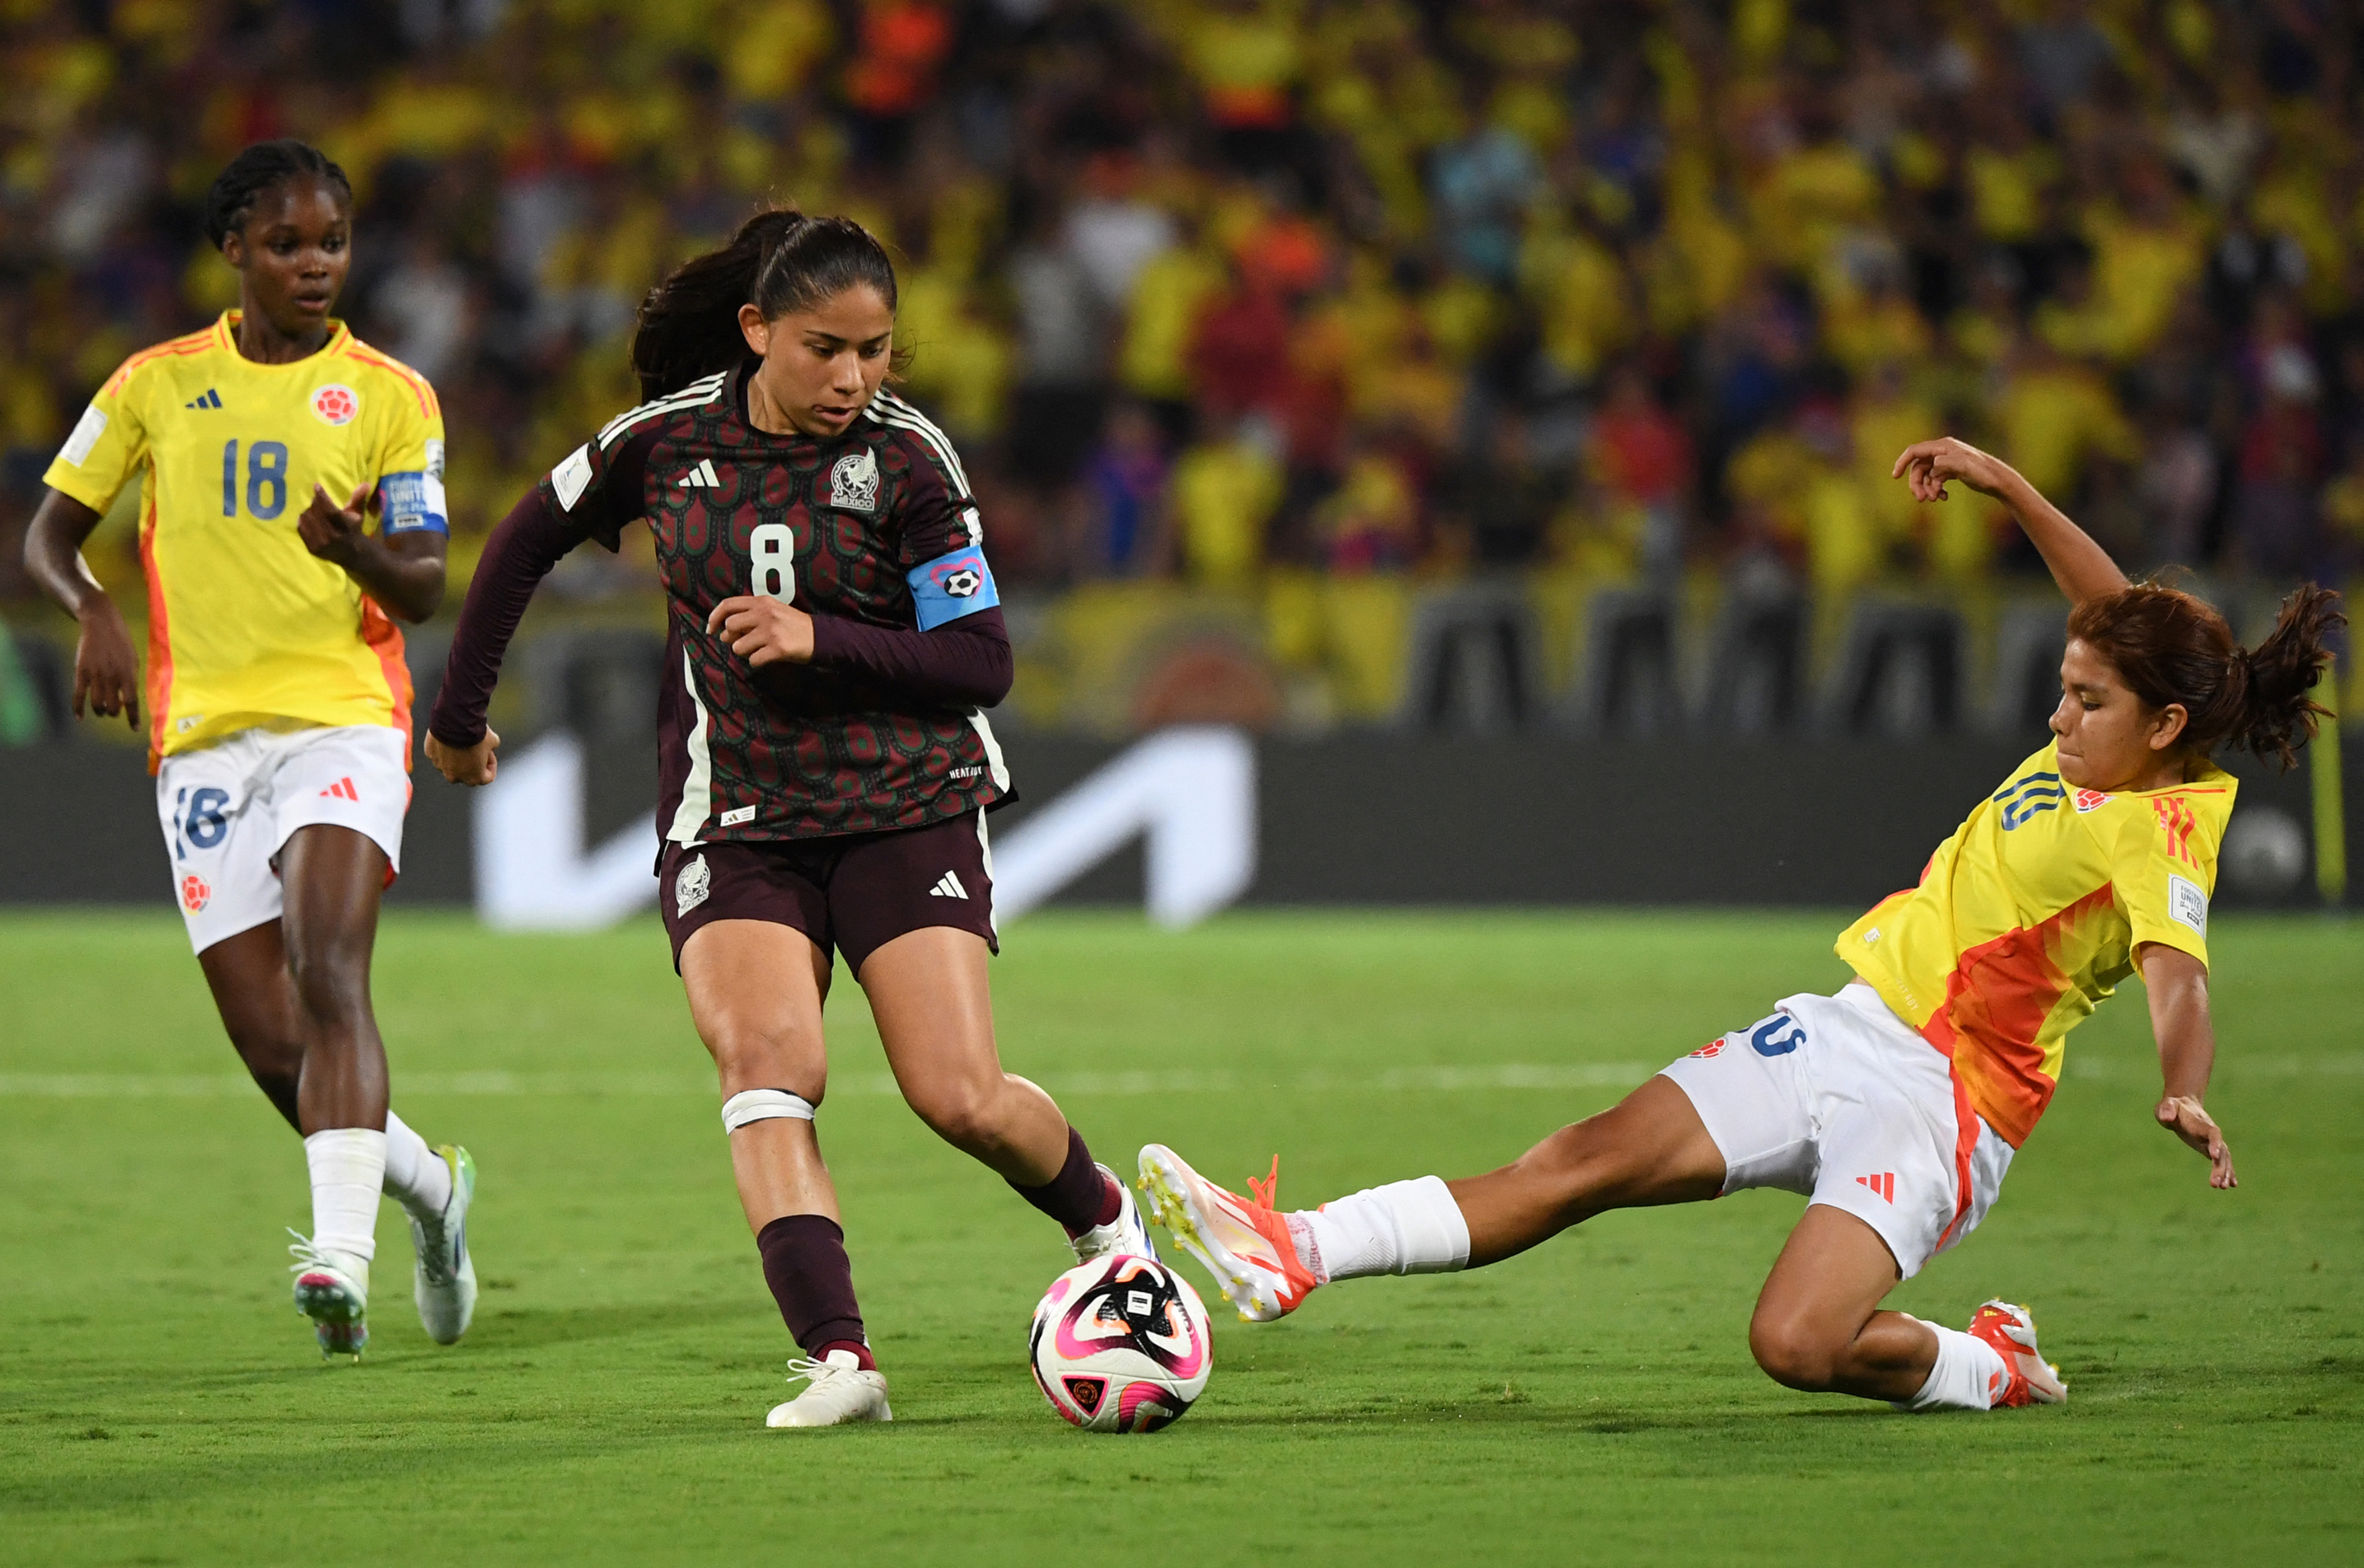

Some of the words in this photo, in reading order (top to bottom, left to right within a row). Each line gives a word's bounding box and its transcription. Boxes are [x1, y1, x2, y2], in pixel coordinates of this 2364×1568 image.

[222, 438, 288, 521] 18
[751, 523, 796, 606] 8
[174, 787, 230, 860] 18
[1993, 772, 2067, 831] 10
